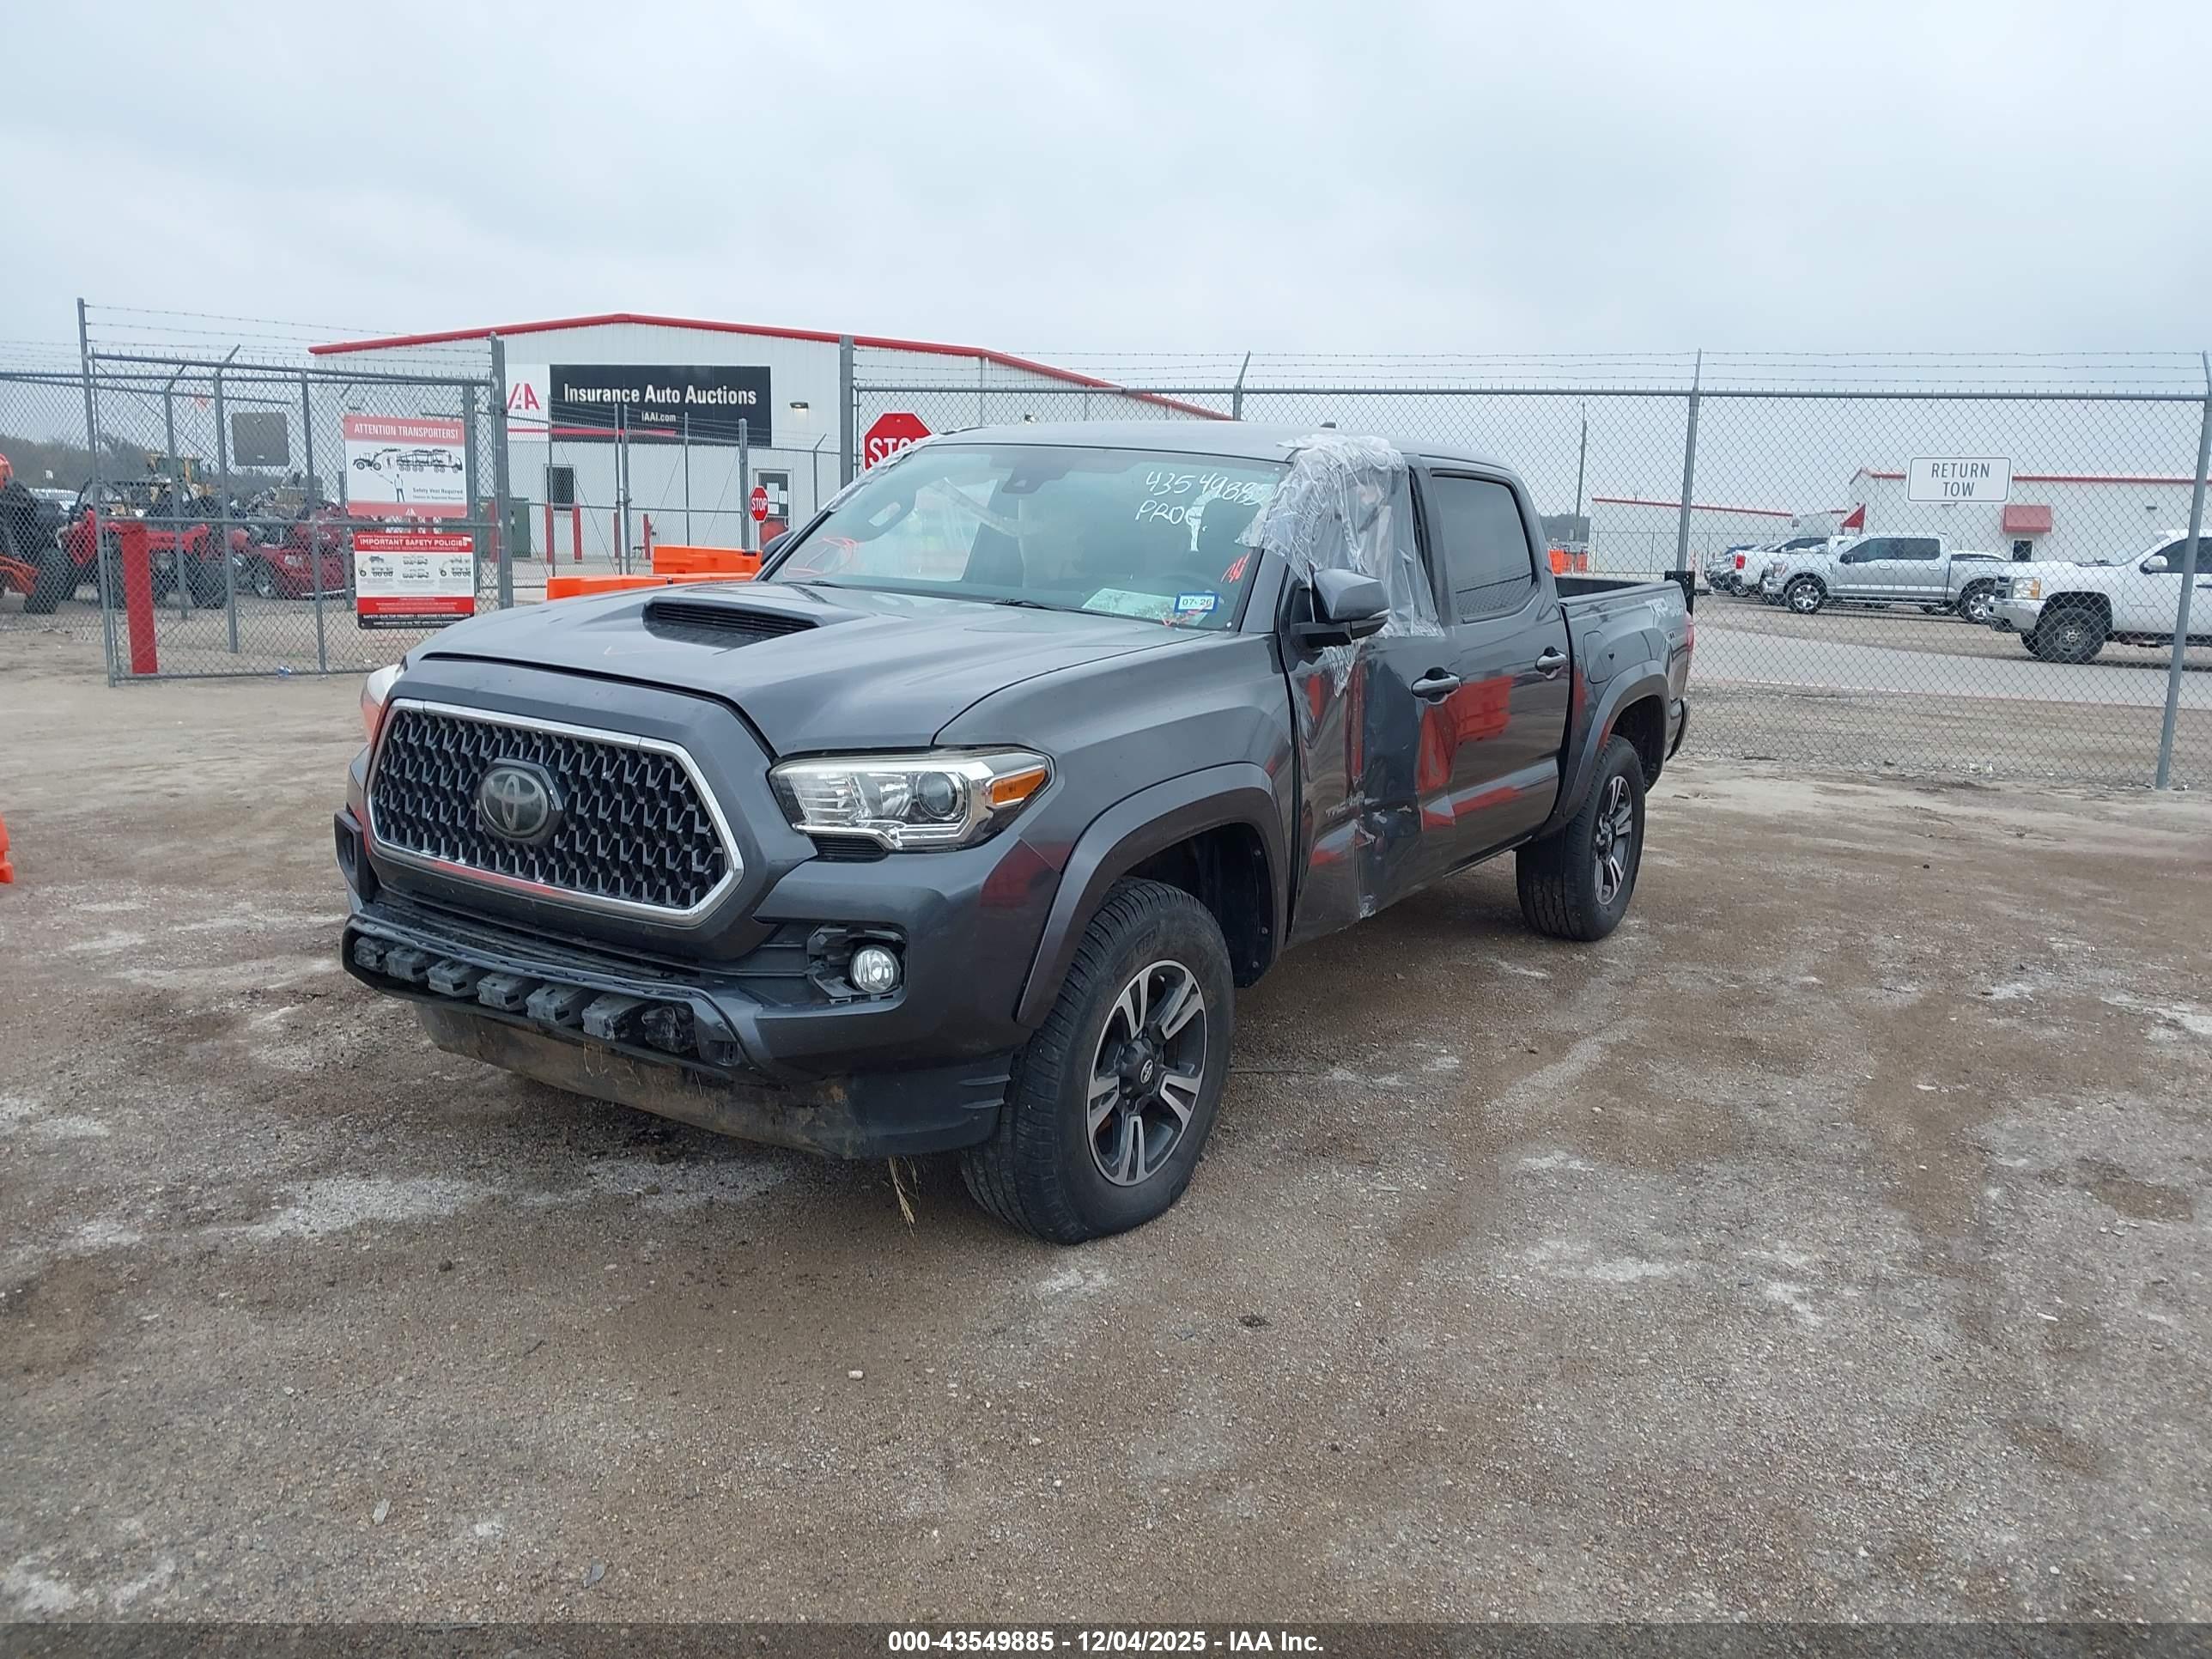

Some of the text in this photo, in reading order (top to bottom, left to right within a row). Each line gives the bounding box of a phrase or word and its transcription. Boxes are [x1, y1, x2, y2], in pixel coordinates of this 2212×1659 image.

[564, 383, 757, 405] Insurance Auto Auctions
[641, 411, 677, 422] IAAI.com
[354, 422, 459, 440] ATTENTION TRANSPORTERS!
[869, 437, 924, 468] ST
[1931, 462, 1990, 478] RETURN
[1943, 482, 1975, 497] TOW
[751, 497, 768, 512] STOP
[360, 538, 404, 546] IMPORTANT
[404, 538, 433, 547] SAFETY
[434, 538, 468, 548] POLICIES
